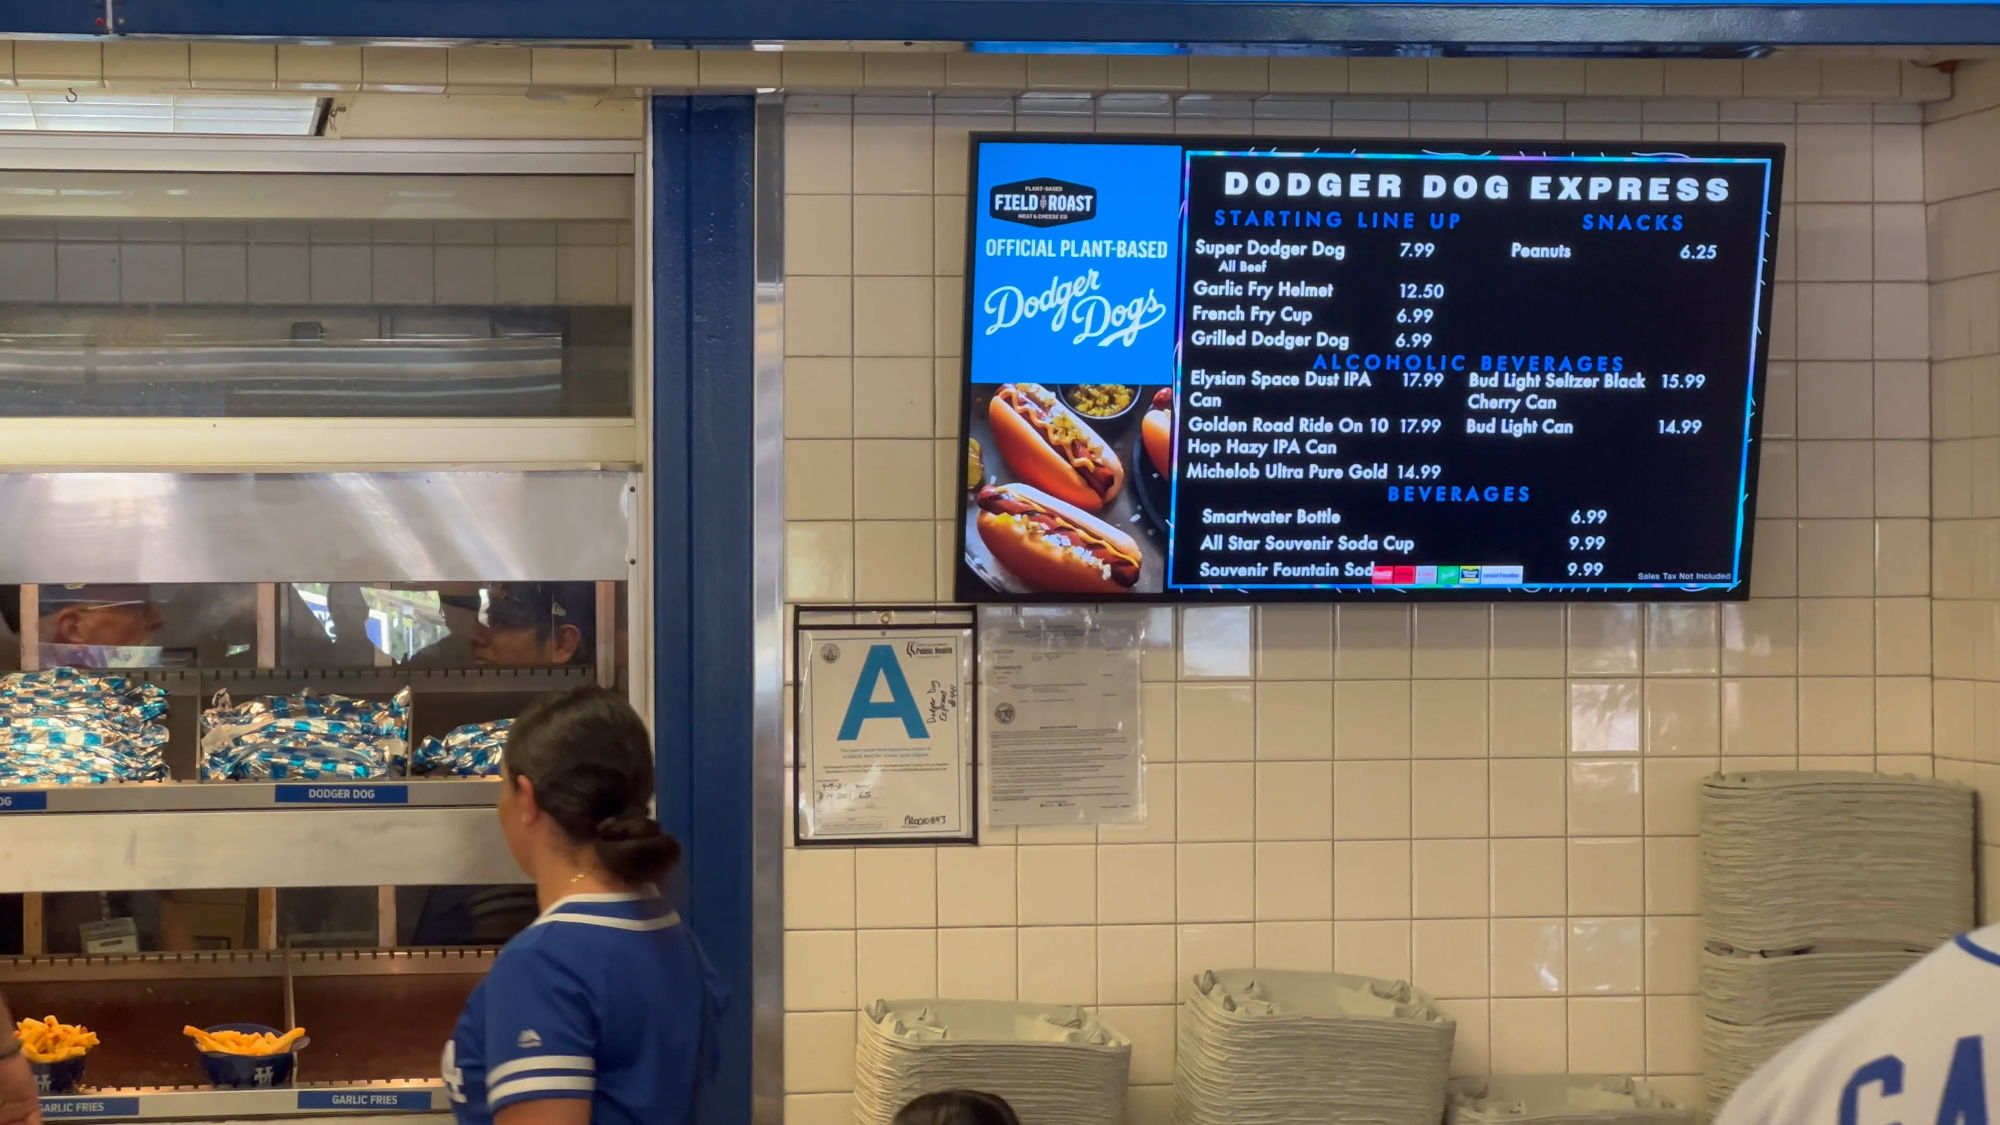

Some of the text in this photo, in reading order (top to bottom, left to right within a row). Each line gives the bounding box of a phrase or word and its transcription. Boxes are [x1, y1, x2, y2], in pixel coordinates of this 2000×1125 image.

[1225, 171, 1729, 202] DODGER DOG EXPRESS
[995, 193, 1093, 211] FIELD ROAST
[1214, 209, 1461, 229] STARTING LINE UP
[1582, 214, 1684, 231] SNACKS
[986, 238, 1168, 259] OFFICIAL PLANT-BASED
[1195, 239, 1435, 260] Super Dodger Dog 7.99
[1511, 242, 1717, 260] Peanuts 6.25
[1218, 260, 1267, 272] All Beef
[1193, 280, 1444, 300] Garlic Fry Helmet 12.50
[984, 268, 1101, 336] Dodger
[1071, 287, 1166, 347] Dogs
[1192, 305, 1434, 326] French Fry Cup 6.99
[1191, 330, 1433, 351] Grilled Dodger Dog 6.99
[1312, 354, 1624, 372] ALCOHOLIC BEVERAGES
[1190, 370, 1444, 389] Elysian Space Dust IPA 17.99
[1468, 372, 1706, 391] Bud Light Seltzer Black 15.99
[1190, 392, 1221, 408] Can
[1467, 393, 1556, 413] Cherry Can
[1188, 416, 1442, 434] Golden Road Ride On 10 17.99
[1466, 418, 1702, 437] Bud Light Can 14.99
[1188, 438, 1337, 458] Hop Hazy IPA Can
[1186, 462, 1442, 480] Michelob Ultra Pure Gold 14.99
[1387, 486, 1530, 502] BEVERAGES
[1202, 507, 1607, 524] Smartwater Bottle 6.99
[1200, 534, 1605, 554] All Star Souvenir Soda Cup 9.99
[1200, 561, 1604, 578] Souvenir Fountain Sod 9.99
[1638, 572, 1731, 580] Sales Tax Not Included
[837, 644, 931, 741] A
[309, 788, 375, 799] DODGER DOG
[76, 1102, 104, 1112] FRIES
[332, 1094, 398, 1105] GARLIC FRIES
